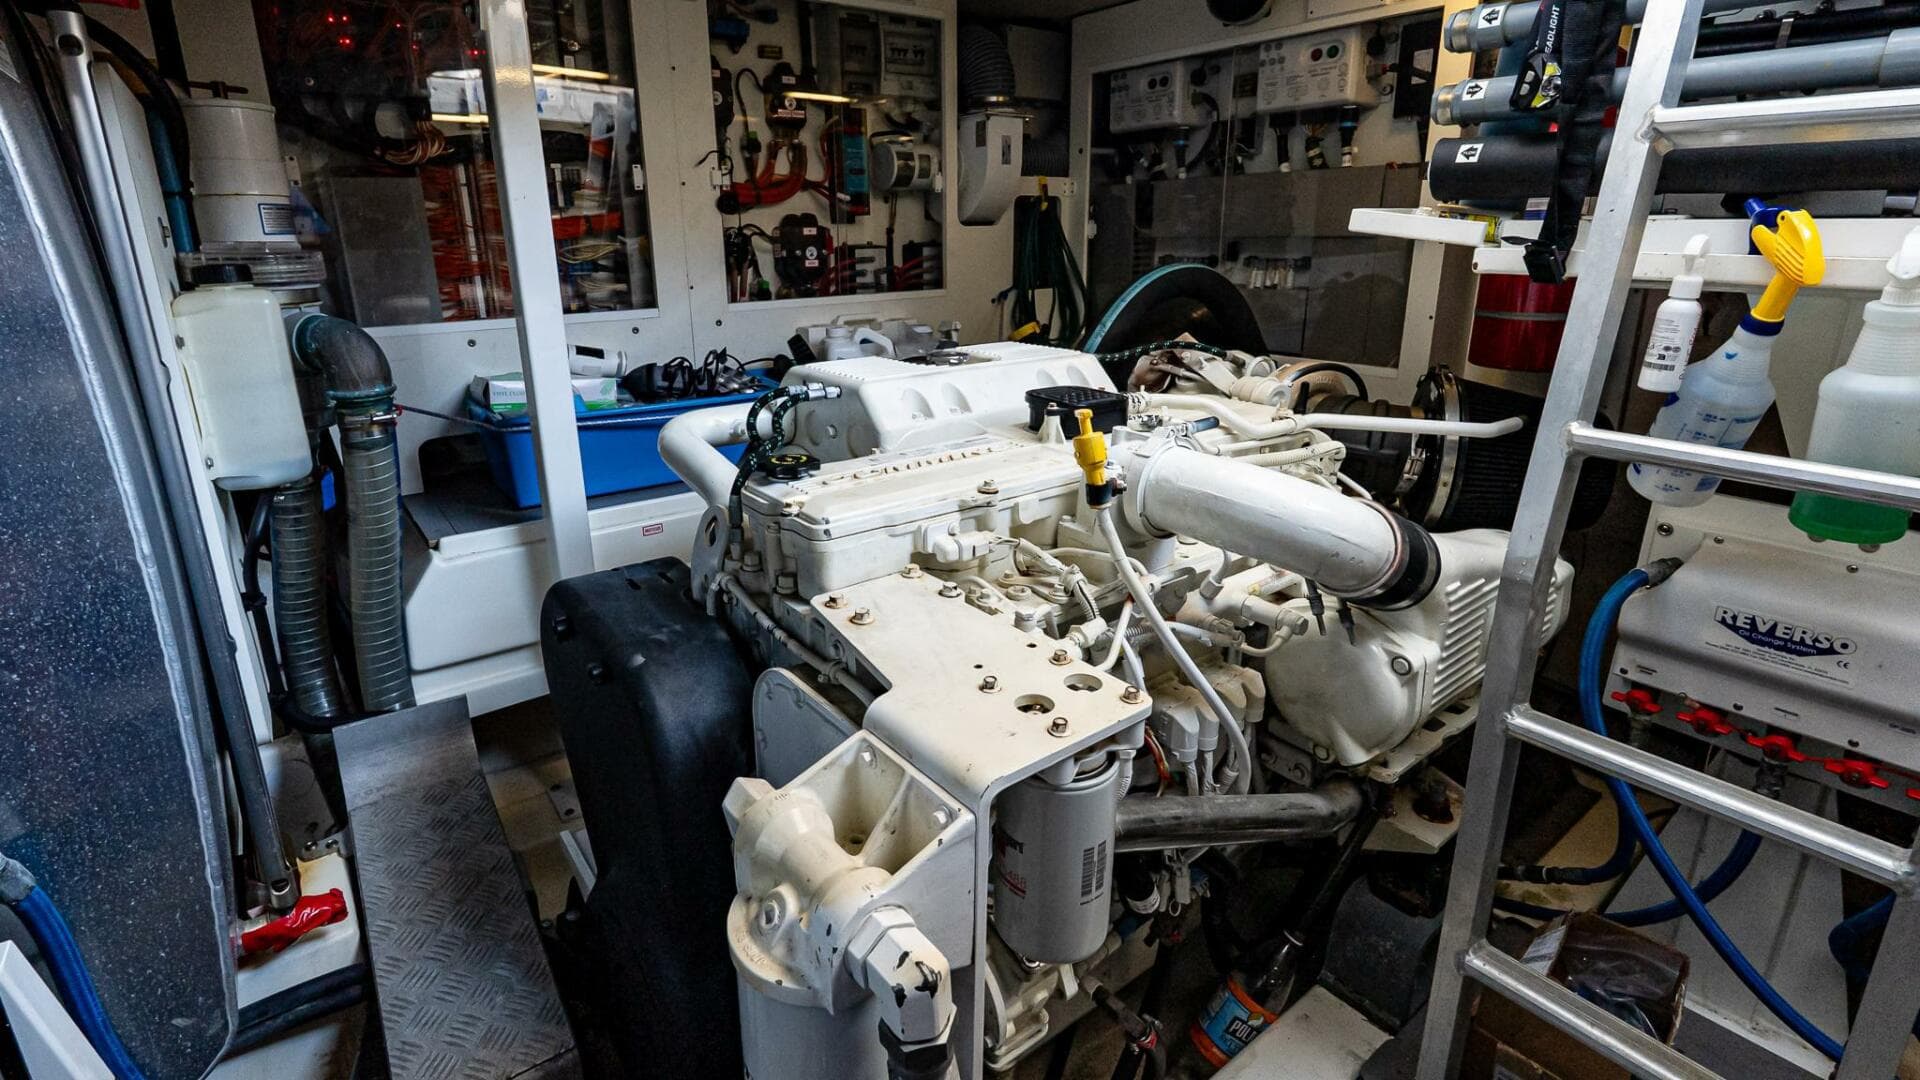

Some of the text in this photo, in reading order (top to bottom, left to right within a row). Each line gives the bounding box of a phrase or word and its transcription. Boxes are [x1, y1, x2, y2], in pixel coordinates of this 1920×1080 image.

[1544, 4, 1560, 56] EADLIGHT
[1714, 606, 1857, 655] REVERSO
[1752, 632, 1785, 645] Change
[1787, 642, 1817, 655] System
